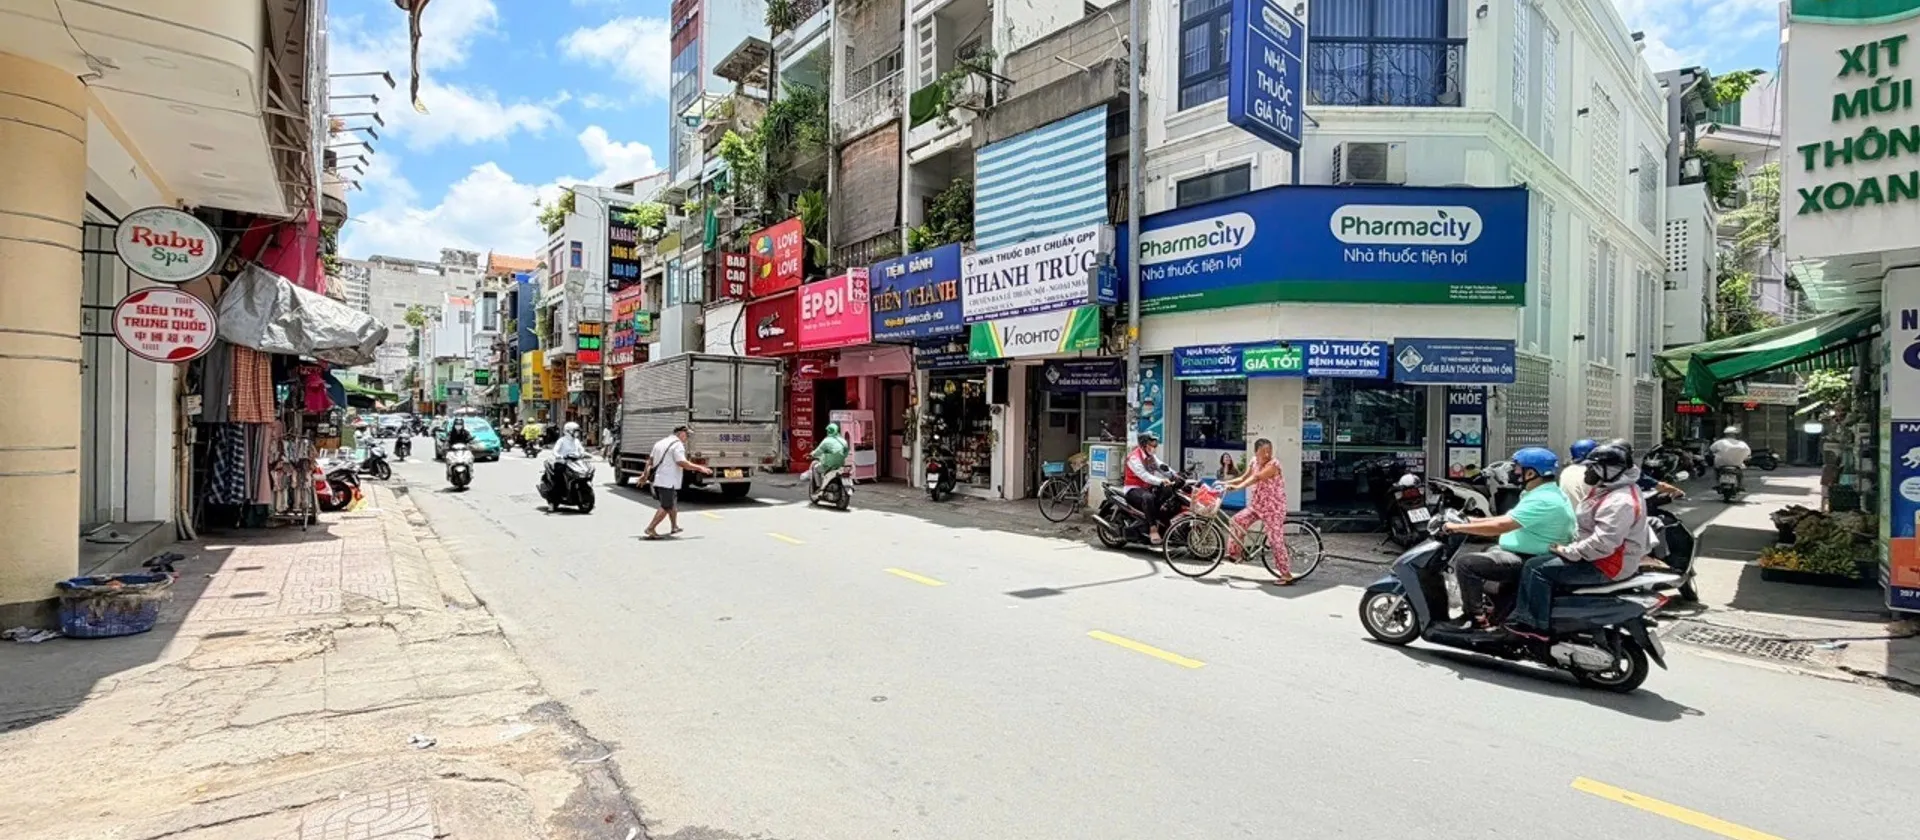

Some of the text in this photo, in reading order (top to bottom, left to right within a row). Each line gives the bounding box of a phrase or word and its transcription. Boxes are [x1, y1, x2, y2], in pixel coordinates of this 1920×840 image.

[1264, 45, 1287, 77] NHÀ
[1836, 34, 1908, 78] XỊT
[1257, 69, 1292, 107] THUỐC
[1831, 75, 1912, 122] MŨI
[1254, 98, 1293, 133] GIÁ TỐT
[1340, 210, 1471, 241] Pharmacity
[131, 225, 203, 256] Ruby
[777, 230, 798, 250] LOVE
[978, 255, 994, 266] NHÀ
[996, 247, 1022, 262] THUỐC
[1025, 245, 1041, 257] ĐẠT
[1077, 231, 1096, 244] GPP
[1140, 222, 1245, 259] Pharmacity
[151, 246, 189, 266] Spa
[726, 254, 747, 268] BAO
[909, 256, 933, 273] BÁNH
[1344, 247, 1467, 266] Nhà thuốc tiện lợi
[726, 269, 746, 283] CAO
[777, 260, 798, 277] LOVE
[1141, 253, 1242, 281] Nhà thuốc tiện lợi
[730, 283, 743, 296] SU
[965, 264, 1029, 296] THANH
[906, 278, 957, 307] THÀNH
[136, 303, 196, 319] SIÊU THỊ
[122, 317, 207, 332] TRUNG QUỐC
[1004, 325, 1061, 348] V.ROHTO
[1186, 345, 1232, 356] NHÀ THUỐC
[1309, 341, 1329, 356] ĐỦ
[1332, 342, 1380, 356] THUỐC
[1244, 352, 1300, 369] GIÁ TỐT
[1308, 357, 1380, 368] BỆNH MẠN TÍNH
[1441, 363, 1454, 373] BÁN
[1456, 363, 1480, 374] THUỐC
